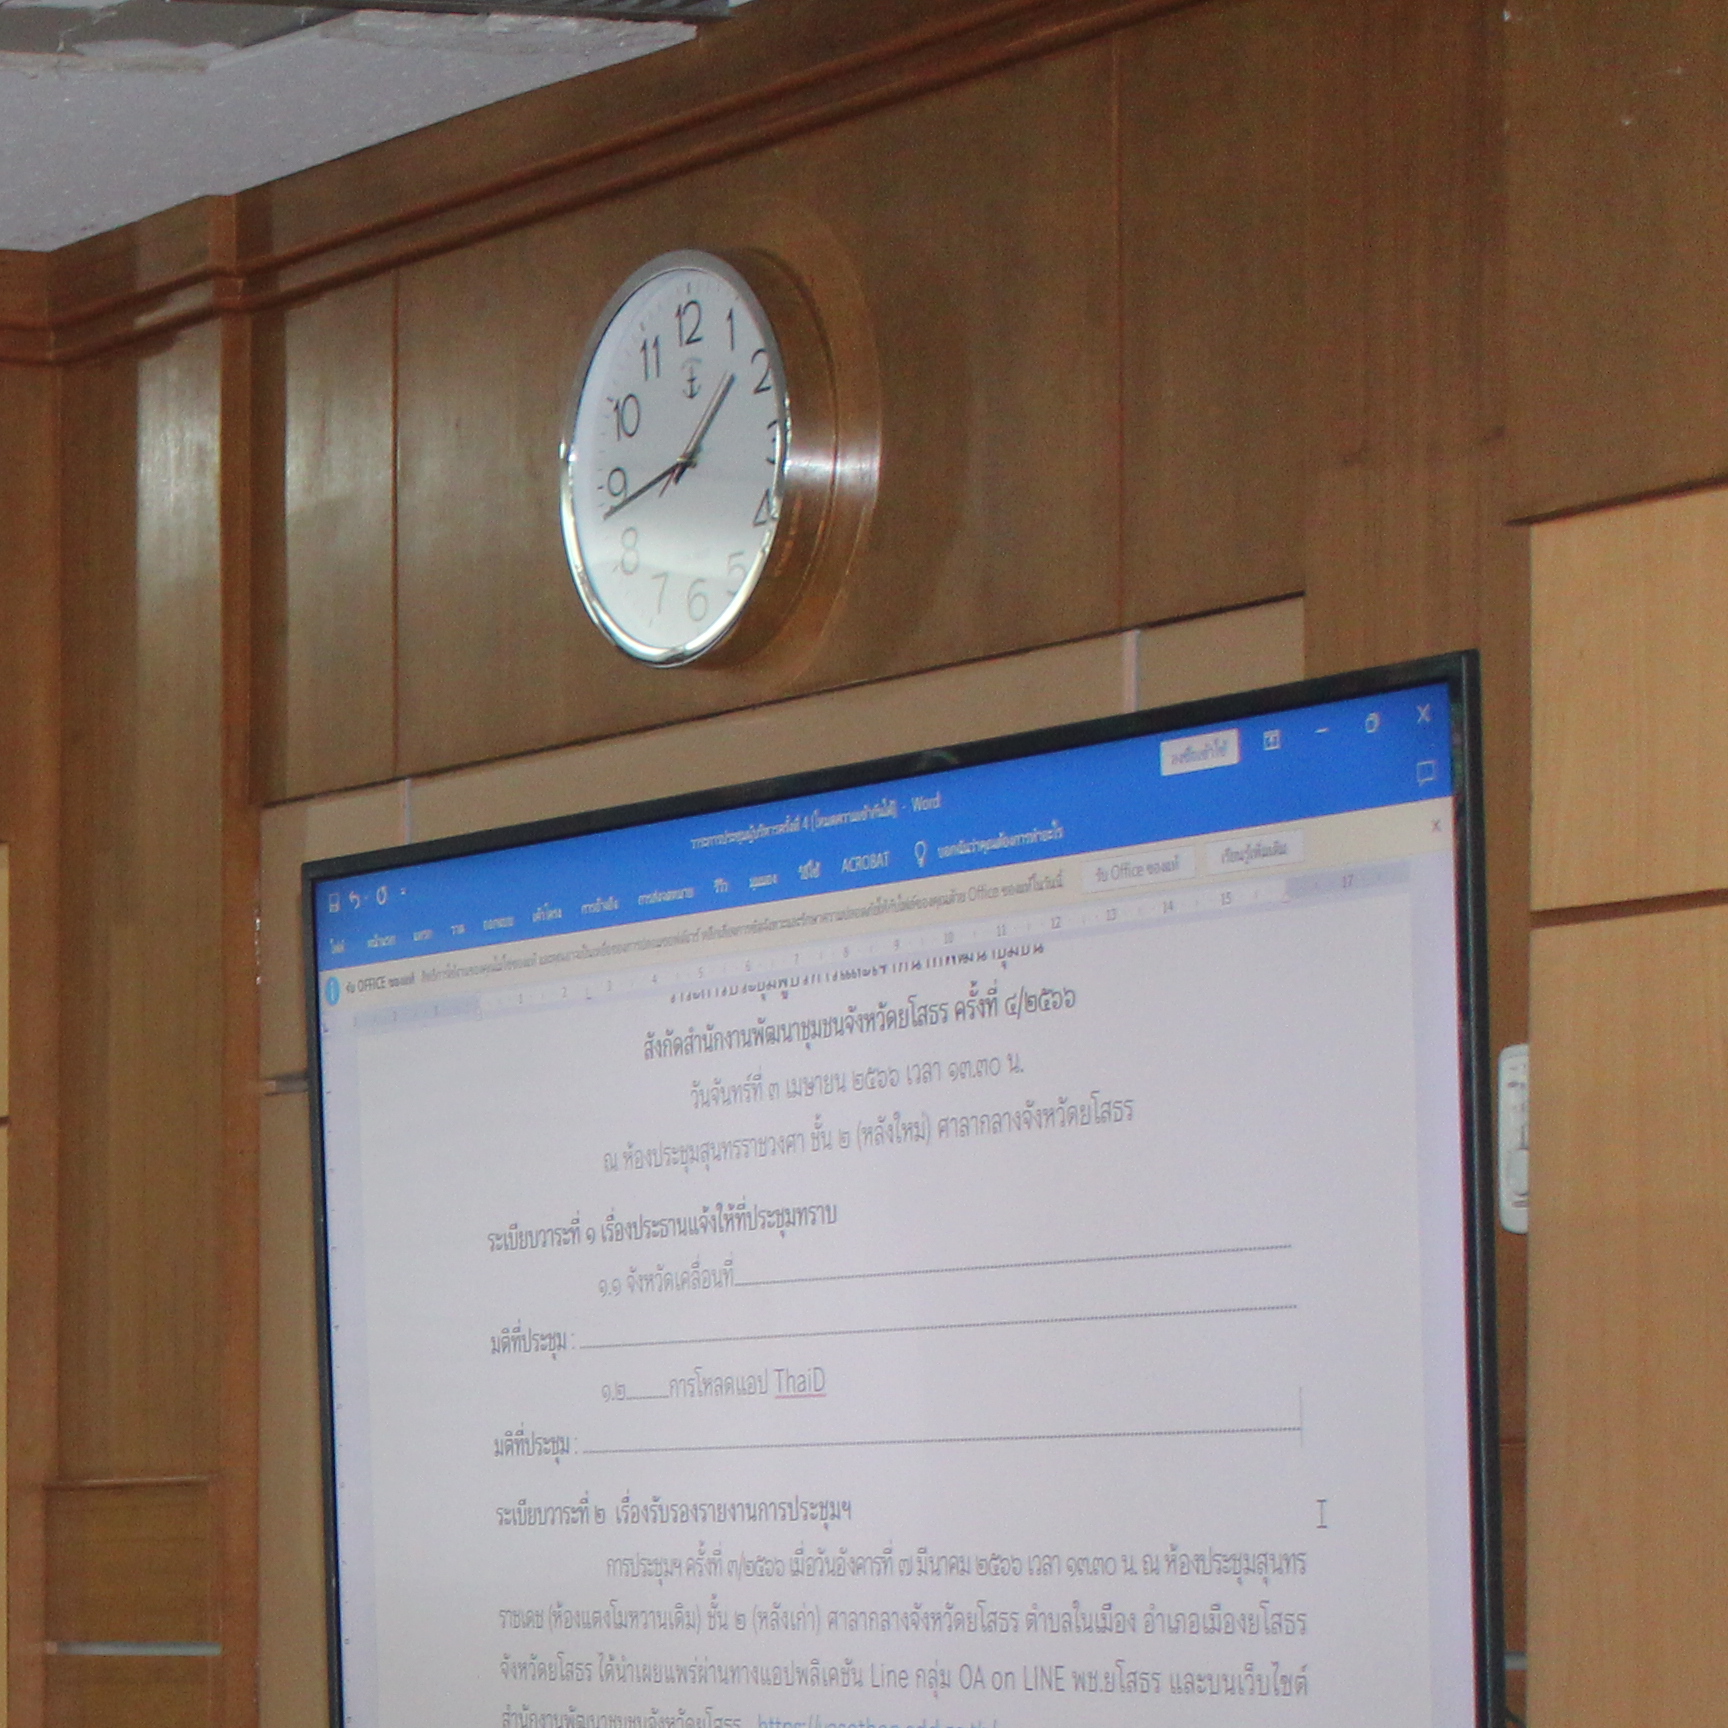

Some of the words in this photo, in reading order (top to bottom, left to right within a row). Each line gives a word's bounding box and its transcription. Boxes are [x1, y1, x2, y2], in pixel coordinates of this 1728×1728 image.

[676, 299, 704, 345] 12
[726, 308, 735, 352] 1
[639, 334, 662, 382] 11
[750, 347, 773, 395] 2
[611, 393, 641, 441] 10
[606, 467, 629, 511] 9
[619, 527, 640, 576] 8
[651, 570, 668, 615] 7
[687, 577, 709, 622] 6
[911, 790, 942, 814] Word
[840, 849, 891, 875] ACROBAT
[1109, 860, 1145, 881] Office
[357, 975, 387, 993] OFFICE
[967, 882, 1000, 903] Office
[642, 988, 949, 1069] สังกัดสำนักงานพัฒนาชุมชนจังหวัดยโสธร
[952, 976, 999, 1023] ครั้งที่
[1003, 977, 1077, 1022] ๔/๒๕๖๖
[689, 1064, 764, 1110] วันจันทร์ที่
[767, 1080, 781, 1102] ๓
[785, 1070, 847, 1100] เมษายน
[851, 1062, 900, 1093] ๒๕๖๖
[904, 1062, 942, 1086] เวลา
[947, 1055, 1002, 1082] ๑๓.๓๐
[1005, 1052, 1025, 1076] น.
[602, 1149, 619, 1173] ณ
[808, 1110, 833, 1152] ชั้น
[837, 1127, 851, 1150] ๒
[855, 1107, 932, 1152] (หลังใหม่)
[936, 1085, 1135, 1139] ศาลากลางจังหวัดยโสธร
[486, 1209, 582, 1254] ระเบียบวาระที่
[584, 1224, 597, 1247] ๑
[599, 1187, 839, 1252] เรื่องประธานแจ้งให้ที่ประชุมทราบ
[489, 1314, 568, 1364] มติที่ประชุม
[773, 1364, 827, 1398] ThaiD
[492, 1420, 571, 1467] มติที่ประชุม
[494, 1488, 591, 1527] ระเบียบวาระที่
[592, 1505, 607, 1526] ๒
[613, 1483, 853, 1532] เรื่องรับรองรายงานการประชุมฯ
[605, 1553, 683, 1587] การประชุมฯ
[684, 1538, 723, 1578] ครั้งที่
[725, 1549, 787, 1581] ๓/๒๕๖๖
[787, 1538, 894, 1578] เมื่อวันอังคารที่
[897, 1555, 914, 1578] ๗
[914, 1545, 972, 1578] มีนาคม
[973, 1549, 1023, 1577] ๒๕๖๖
[1025, 1553, 1062, 1576] เวลา
[1140, 1552, 1161, 1576] ณ
[1163, 1540, 1308, 1587] ห้องประชุมสุนทร
[705, 1591, 728, 1631] ชั้น
[732, 1609, 747, 1631] ๒
[751, 1600, 822, 1636] (หลังเก่า)
[826, 1597, 1021, 1635] ศาลากลางจังหวัดยโสธร
[1023, 1598, 1138, 1635] ตำบลในเมือง
[1141, 1598, 1309, 1637] อำเภอเมืองยโสธร
[498, 1649, 594, 1684] จังหวัดยโสธร
[596, 1650, 864, 1690] ได้นำเผยแพร่ผ่านทางแอปพลิเคชัน
[869, 1660, 910, 1689] Line
[913, 1657, 952, 1701] กลุ่ม
[957, 1662, 986, 1691] OA
[990, 1668, 1018, 1692] on
[1022, 1663, 1066, 1693] LINE
[1070, 1657, 1163, 1695] พช.ยโสธร
